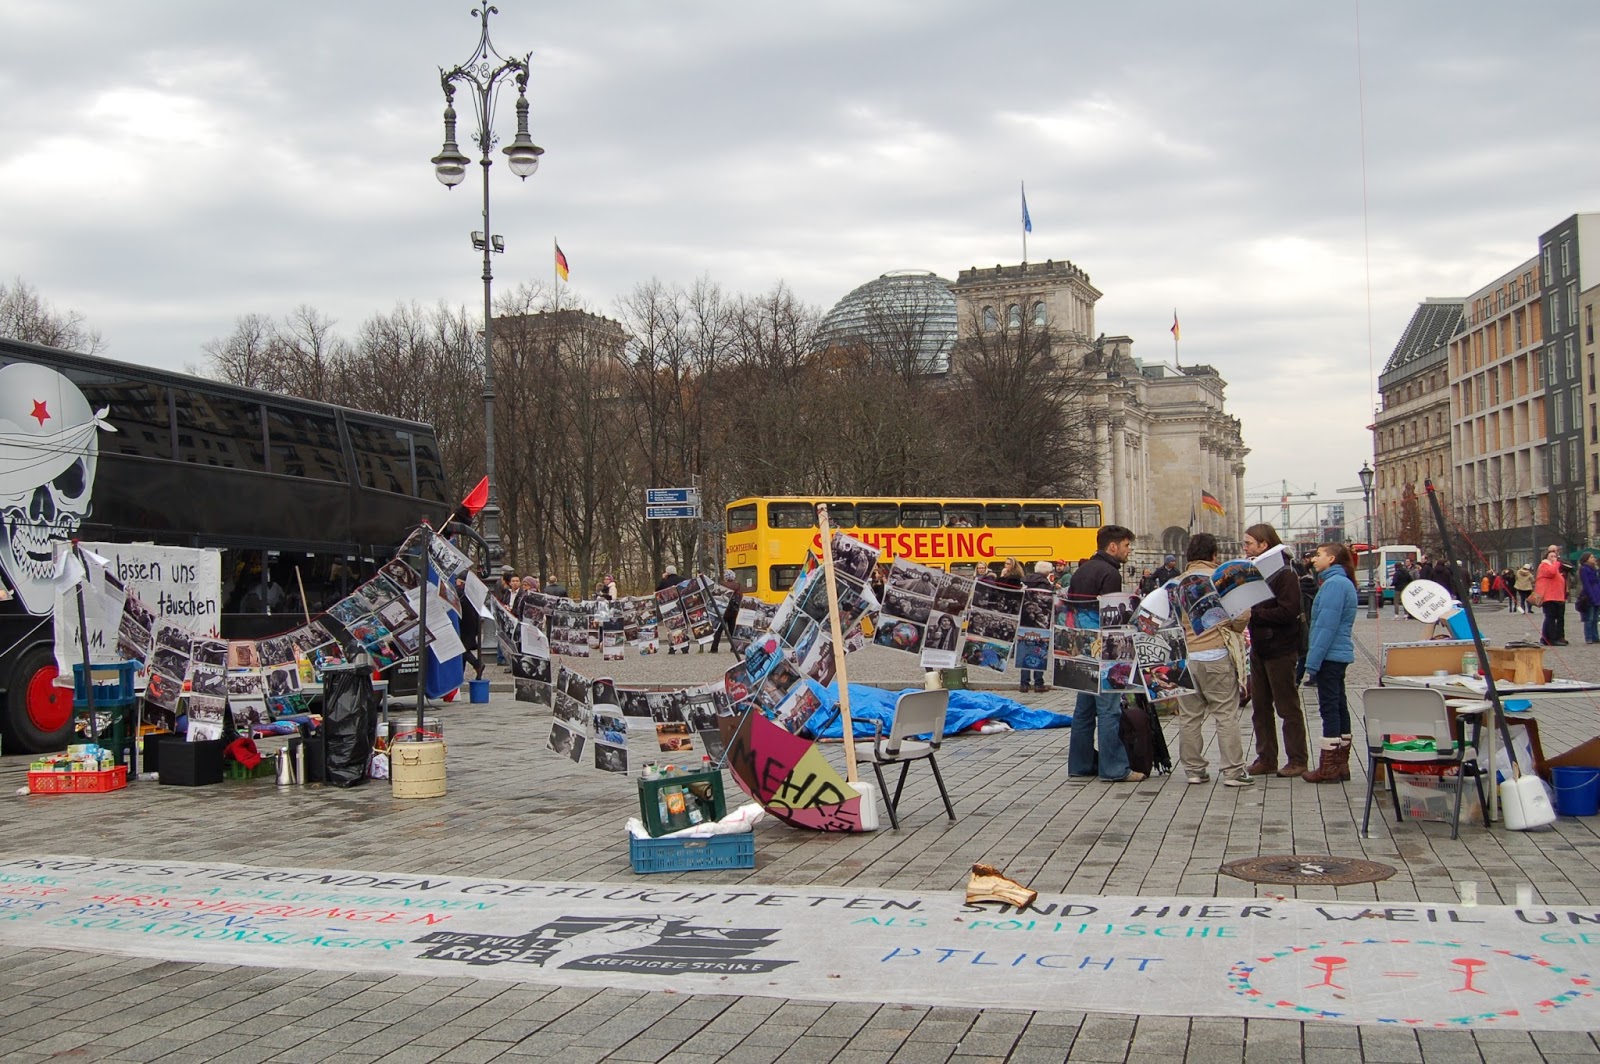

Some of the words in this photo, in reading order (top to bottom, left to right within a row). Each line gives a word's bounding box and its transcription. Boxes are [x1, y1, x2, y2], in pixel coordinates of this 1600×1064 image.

[812, 533, 995, 558] SHTSEEING
[117, 554, 161, 581] lassen
[172, 563, 195, 583] uns
[157, 590, 216, 617] täuschen
[1414, 591, 1435, 609] Mensch
[1316, 906, 1485, 923] WEIL
[430, 933, 479, 944] WE
[479, 937, 549, 949] WILL
[433, 945, 550, 963] RISE
[579, 957, 690, 970] REFUGEE
[689, 962, 764, 972] STRIKE
